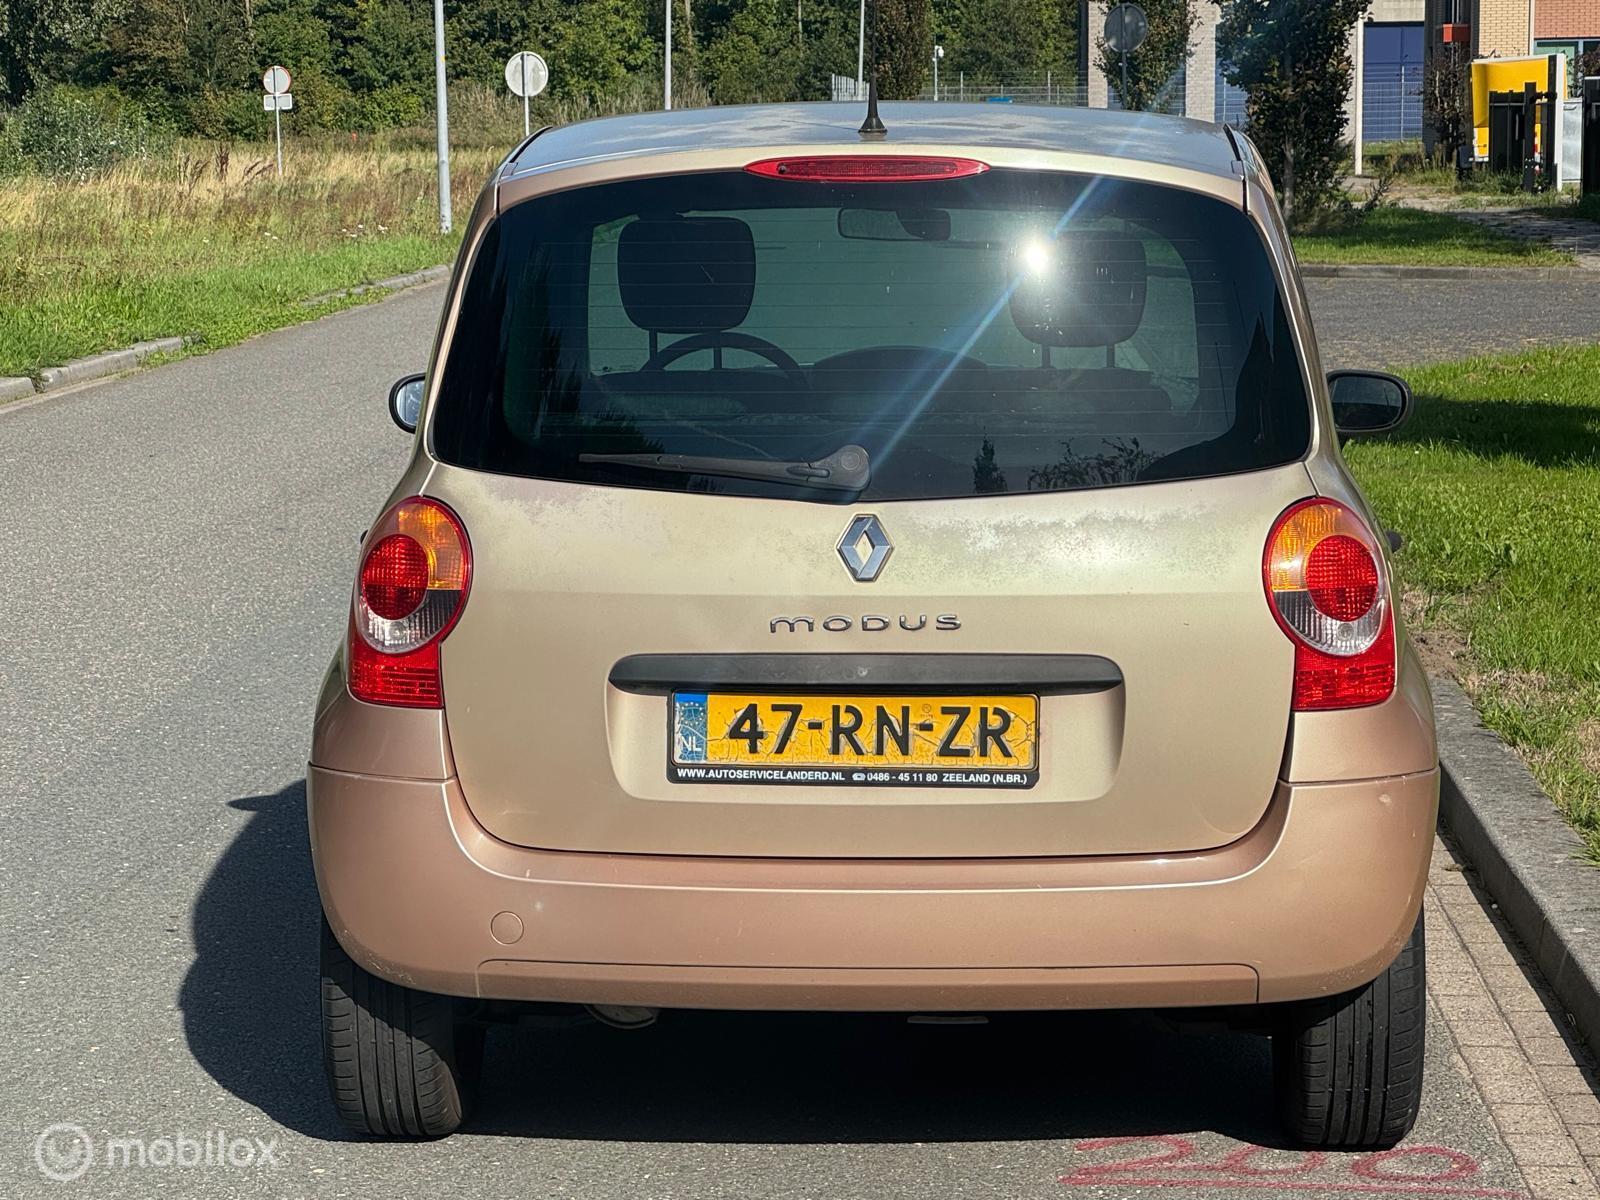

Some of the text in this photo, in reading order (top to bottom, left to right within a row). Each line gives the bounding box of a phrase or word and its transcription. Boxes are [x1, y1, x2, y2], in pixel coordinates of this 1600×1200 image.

[769, 614, 962, 633] MODUS
[728, 703, 1012, 757] 47-RN-ZR
[680, 736, 702, 752] NL
[677, 768, 845, 781] WWW.AUTOSERVICELANDERD.NL
[867, 772, 889, 782] 0486
[898, 772, 910, 782] 45
[913, 772, 924, 782] 11
[926, 773, 938, 783] 80
[942, 773, 990, 783] ZEELAND
[992, 774, 1027, 785] (N.BR.)
